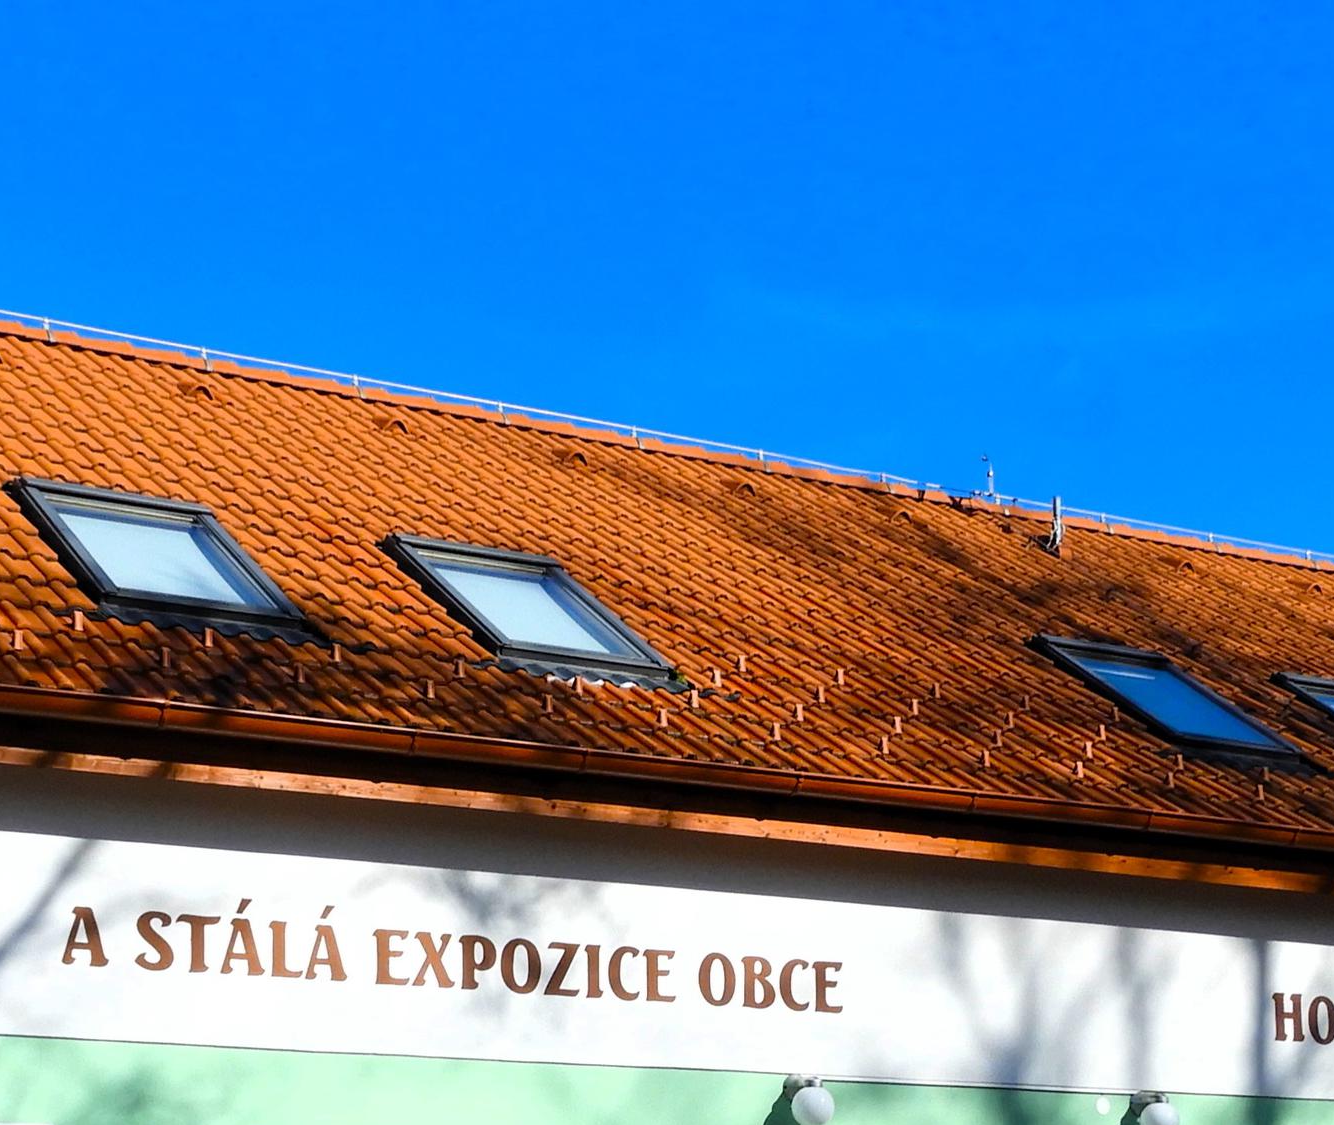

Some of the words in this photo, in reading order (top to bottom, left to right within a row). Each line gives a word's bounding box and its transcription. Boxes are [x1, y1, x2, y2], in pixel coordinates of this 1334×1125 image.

[62, 906, 109, 967] A
[134, 899, 347, 982] STÁLÁ
[373, 929, 676, 1003] EXPOZICE
[698, 952, 843, 1014] OBCE
